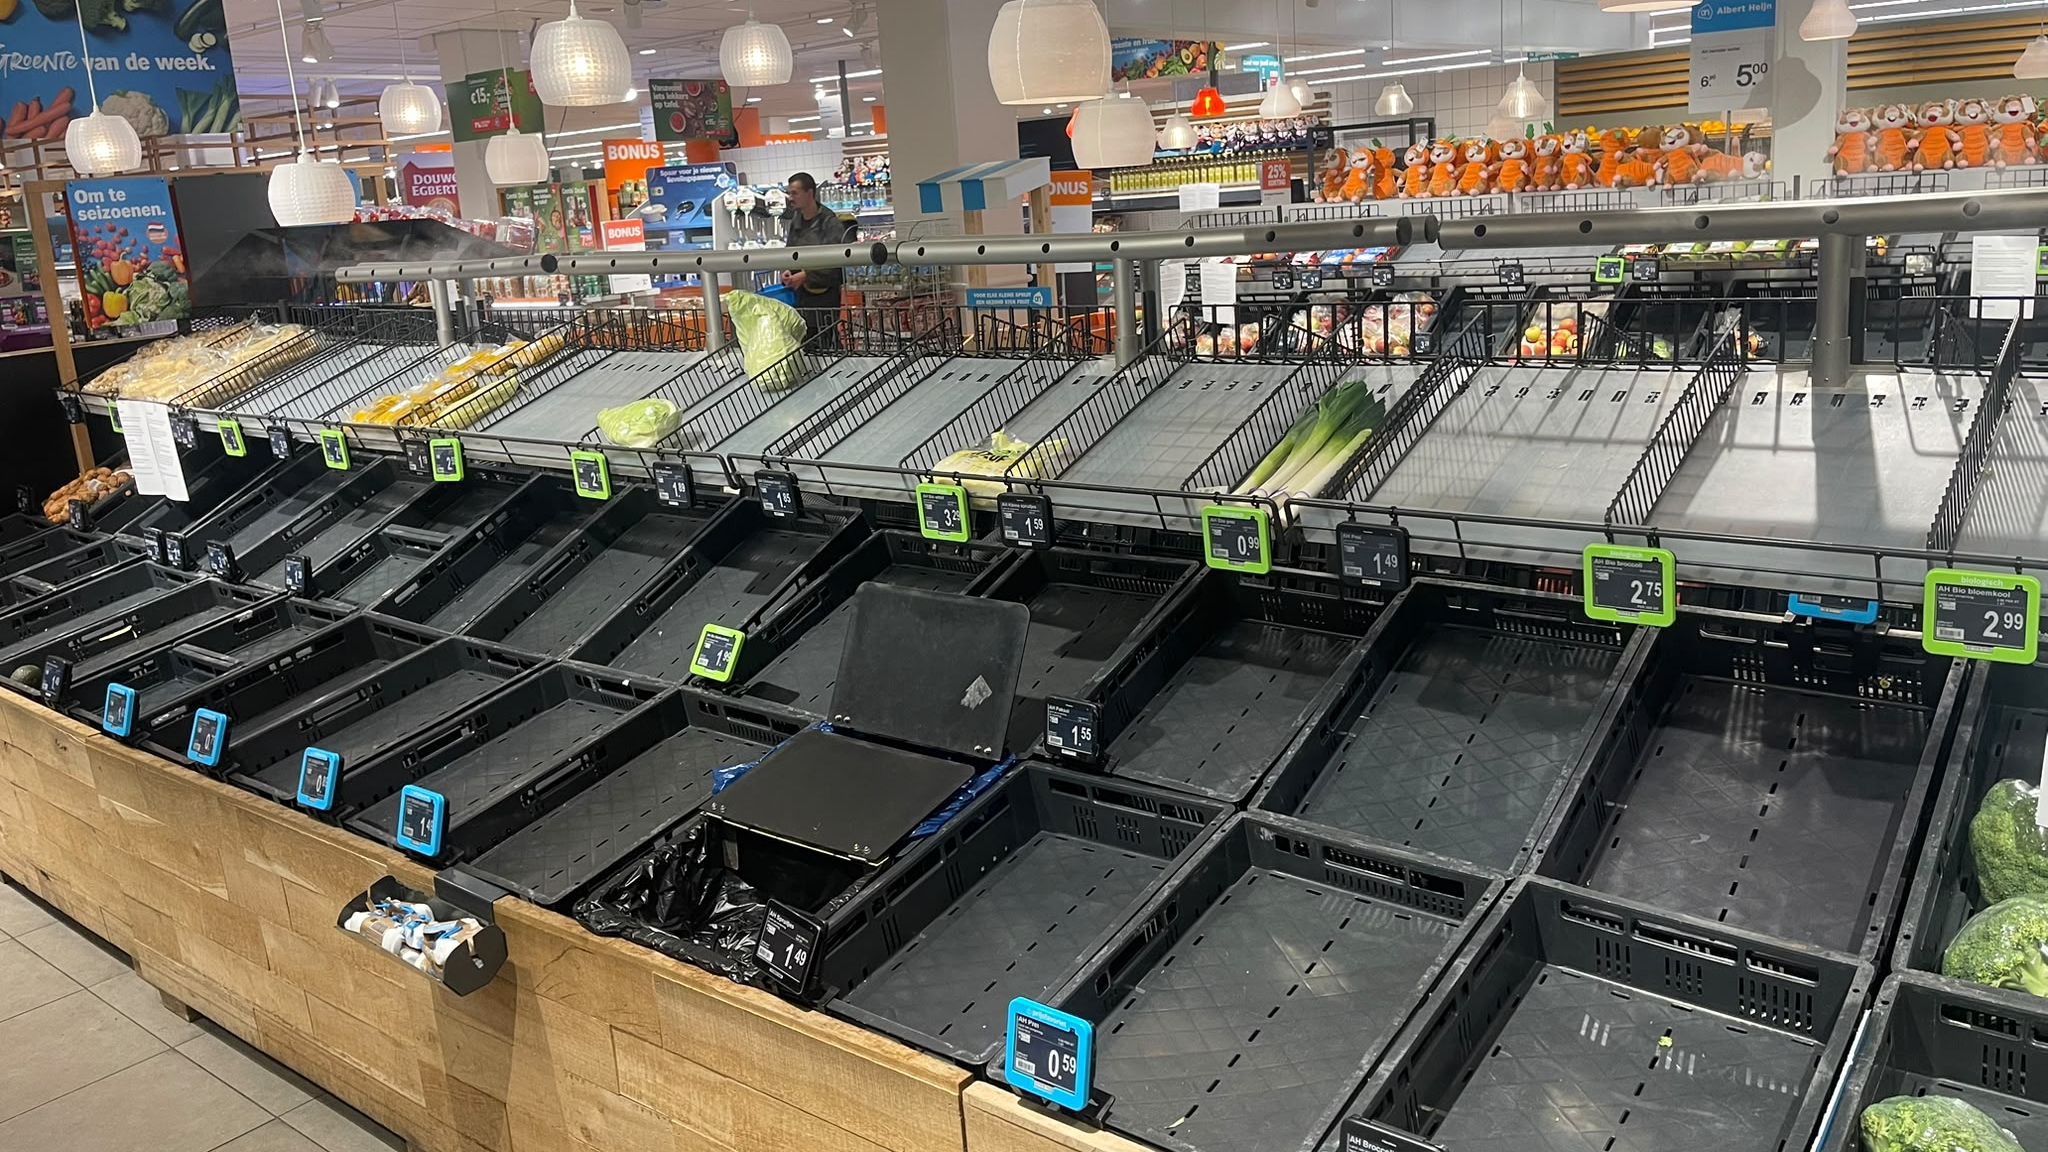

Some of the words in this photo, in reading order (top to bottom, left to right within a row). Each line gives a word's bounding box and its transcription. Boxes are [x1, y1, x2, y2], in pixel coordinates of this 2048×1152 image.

[1717, 5, 1746, 15] Albert
[1748, 2, 1773, 12] Heijn
[81, 55, 120, 71] van
[125, 52, 150, 71] de
[155, 53, 217, 71] week.
[1736, 62, 1769, 87] 5.00
[607, 144, 661, 160] BONUS
[1267, 164, 1287, 179] 25%
[74, 189, 104, 204] Om
[108, 187, 127, 201] te
[77, 204, 167, 221] seizoenen.
[608, 226, 641, 239] BONUS
[1025, 517, 1044, 537] 1.59
[1237, 535, 1260, 556] 0.99
[1373, 552, 1399, 575] 1.49
[1960, 576, 2004, 586] biologisch
[1630, 580, 1662, 605] 2.75
[1968, 588, 2011, 598] bloemkool
[1982, 611, 2024, 639] 2.99
[1071, 725, 1092, 746] 1.55
[784, 943, 808, 970] 1.49
[1019, 1016, 1028, 1024] AH
[1048, 1049, 1077, 1080] 0.59
[1350, 1135, 1361, 1145] AH
